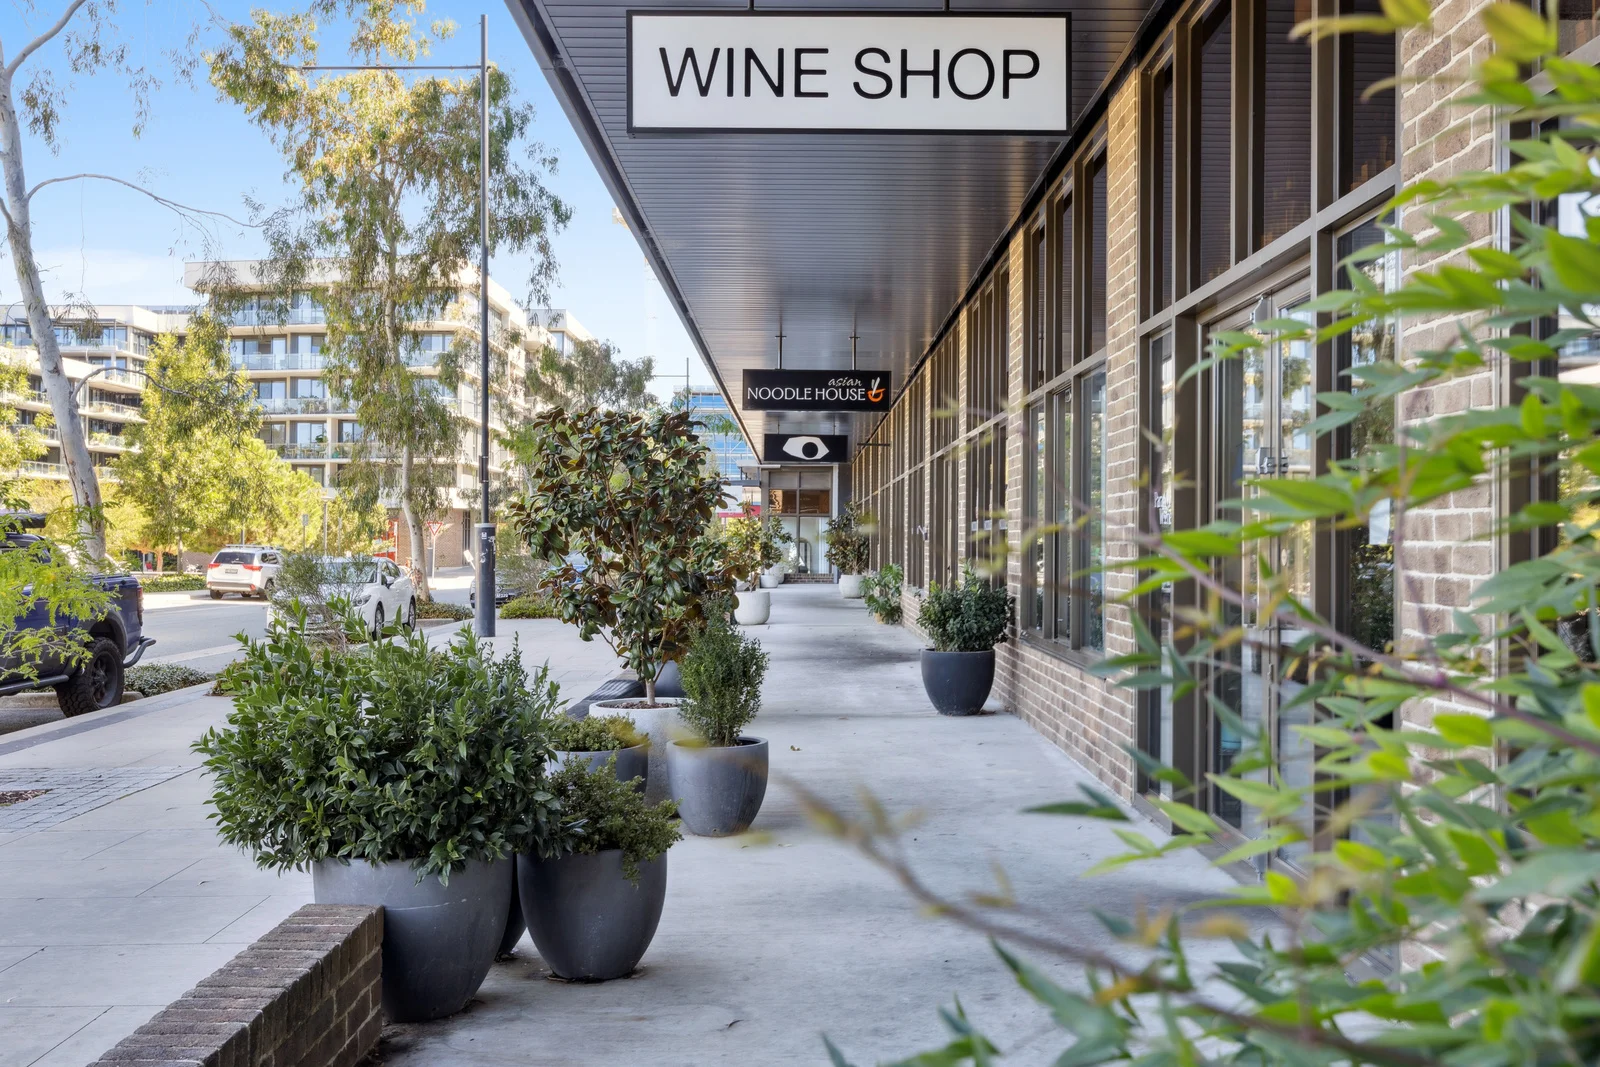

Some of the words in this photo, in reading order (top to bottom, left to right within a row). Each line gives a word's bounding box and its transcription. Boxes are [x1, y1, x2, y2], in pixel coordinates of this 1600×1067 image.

[658, 47, 829, 99] WINE
[852, 48, 1040, 100] SHOP
[827, 376, 863, 388] asian
[746, 386, 813, 401] NOODLE
[814, 387, 866, 402] HOUSE
